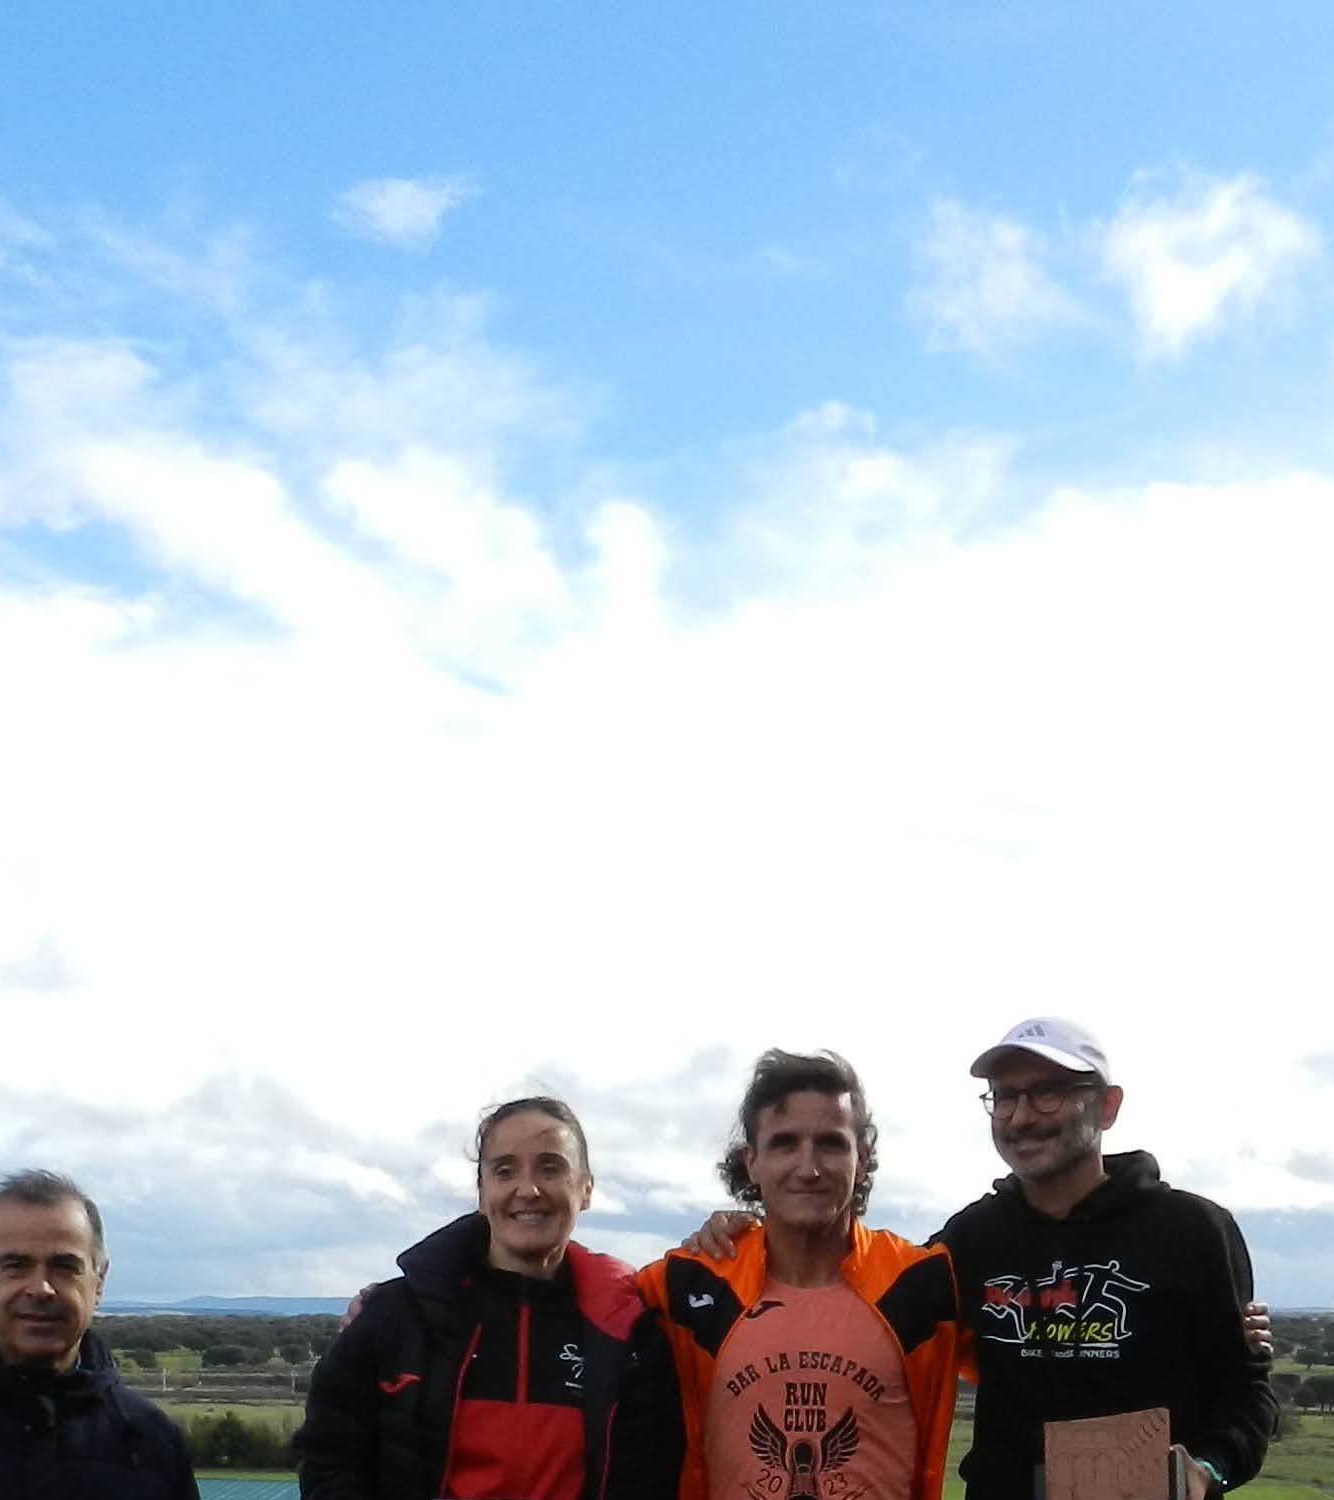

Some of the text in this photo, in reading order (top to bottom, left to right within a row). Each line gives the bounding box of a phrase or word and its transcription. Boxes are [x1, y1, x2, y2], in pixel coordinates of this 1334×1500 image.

[726, 1351, 886, 1401] BAR LA ESCAPADA
[785, 1382, 828, 1406] RUN
[784, 1408, 827, 1432] CLUB
[755, 1468, 848, 1496] 20 23
